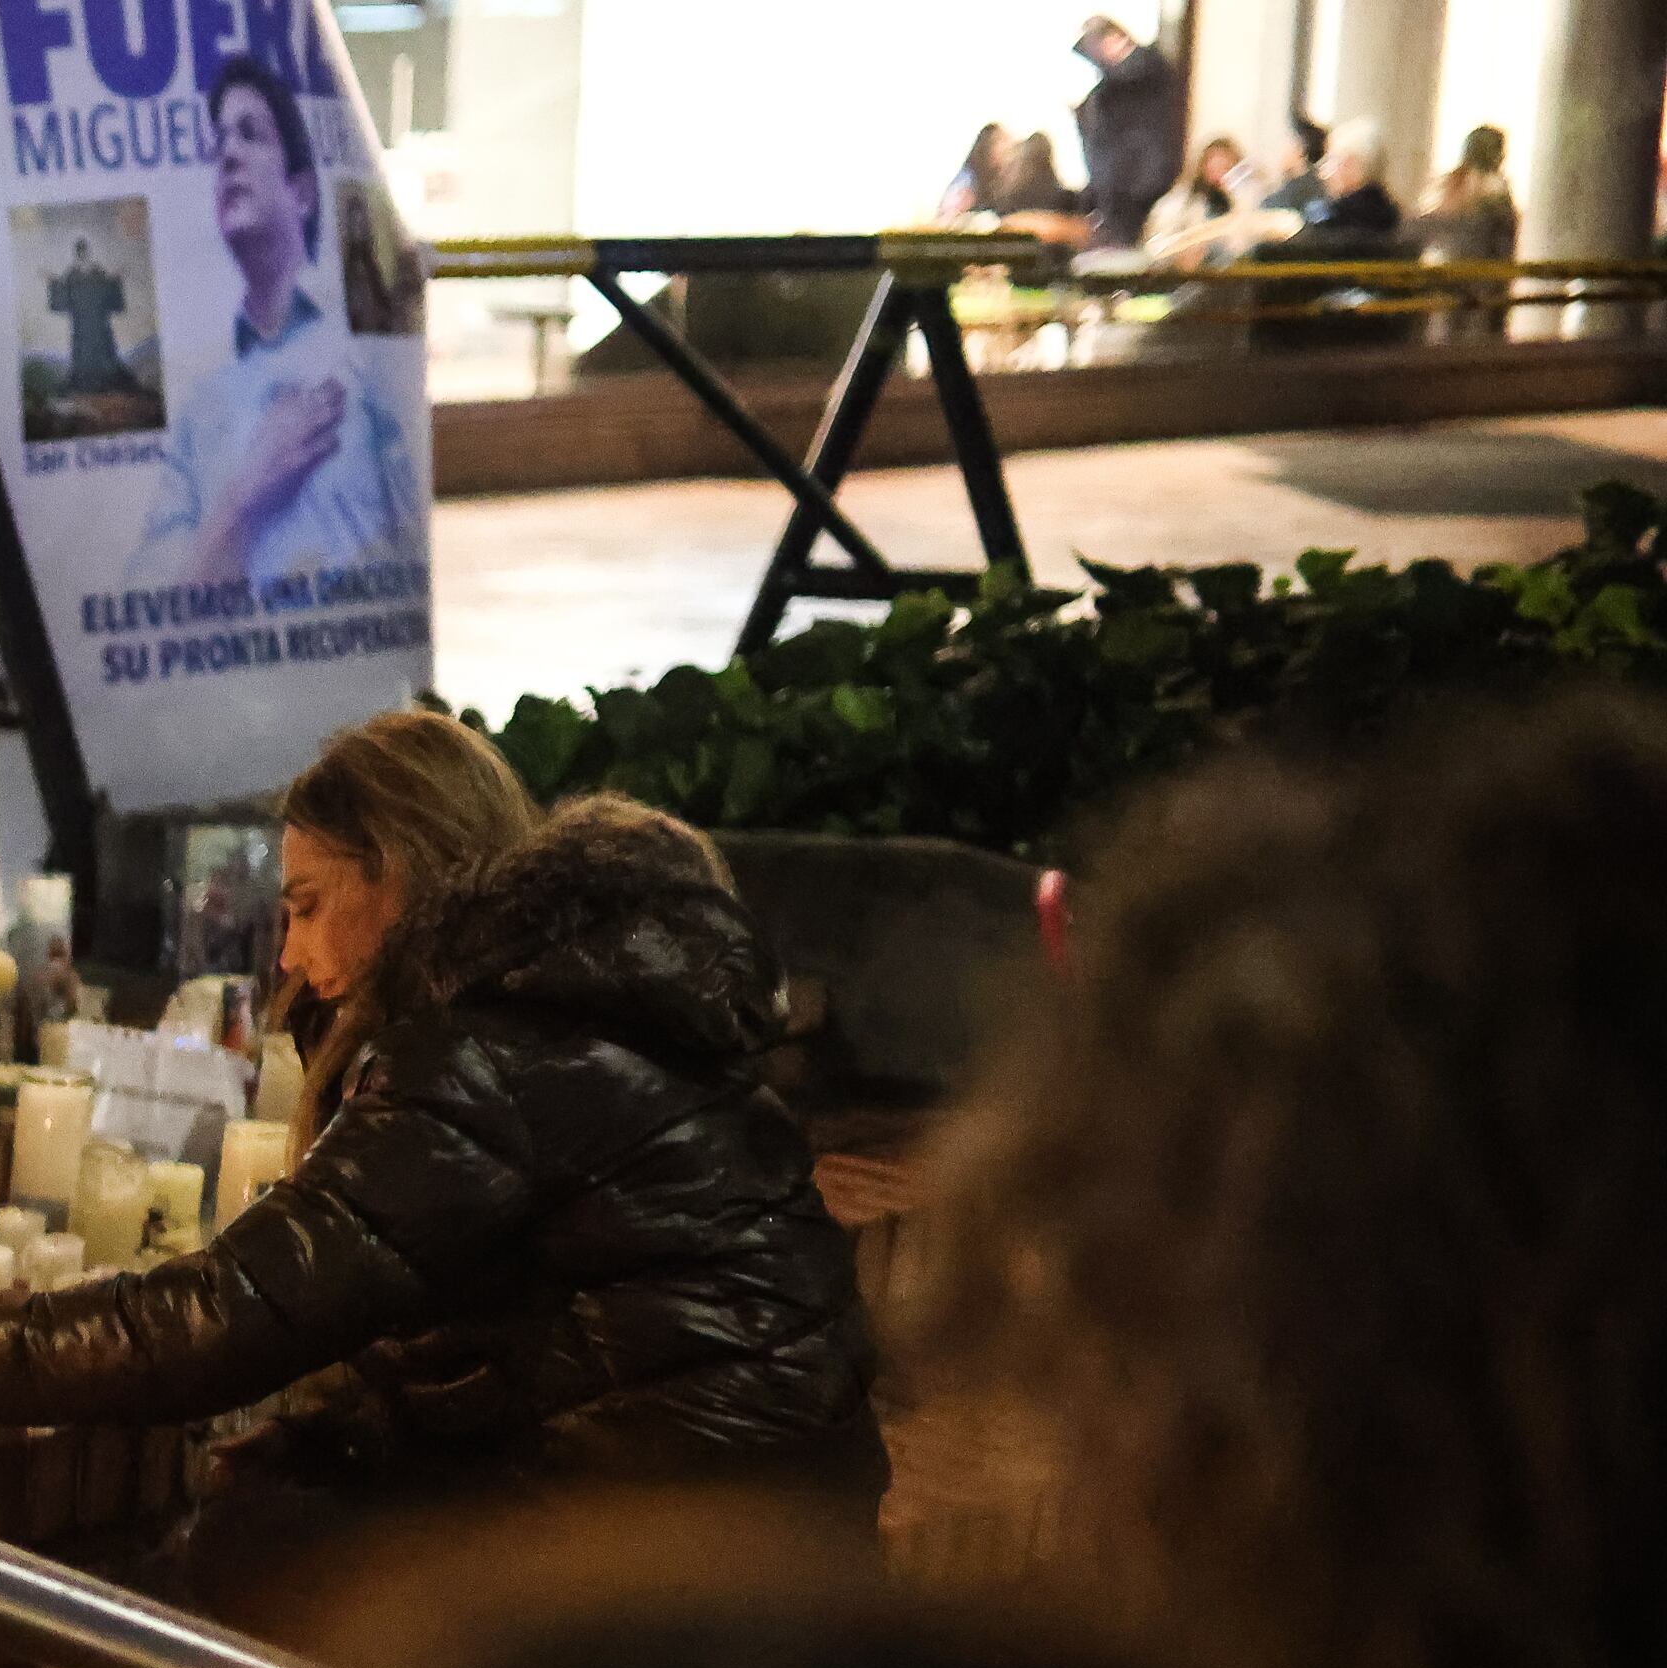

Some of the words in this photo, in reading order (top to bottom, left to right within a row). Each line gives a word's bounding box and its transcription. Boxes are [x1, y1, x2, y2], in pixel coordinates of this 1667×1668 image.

[12, 96, 223, 176] MIGUEL
[82, 577, 254, 634] ELEVEMOS
[101, 642, 150, 684] SU
[159, 627, 281, 678] PRONTA
